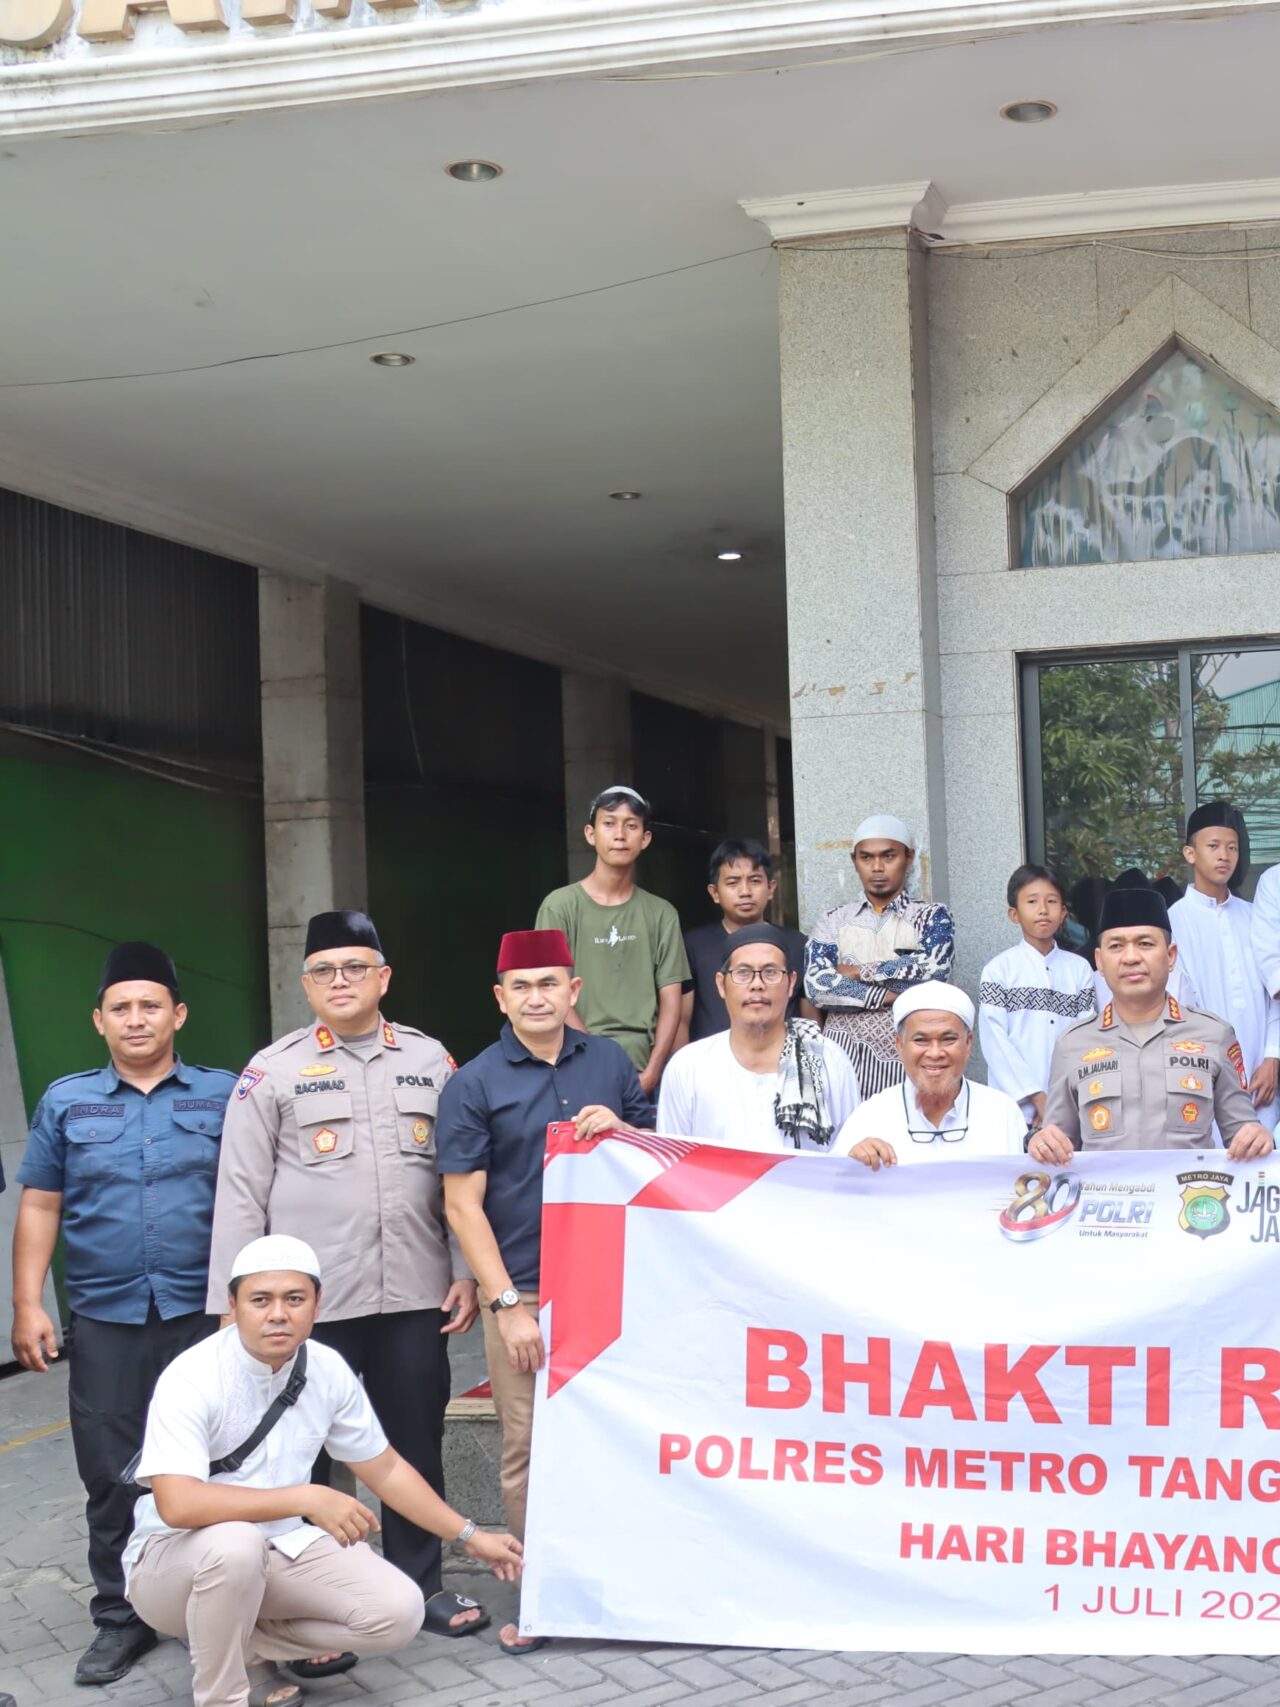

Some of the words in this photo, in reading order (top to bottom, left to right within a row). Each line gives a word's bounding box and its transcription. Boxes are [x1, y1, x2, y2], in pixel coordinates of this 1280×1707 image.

[1170, 1056, 1209, 1070] POLRI
[294, 1079, 346, 1095] RACHMAD
[396, 1075, 434, 1088] POLRI
[1181, 1173, 1208, 1183] METRO
[1210, 1173, 1229, 1183] JAYA
[1108, 1182, 1156, 1194] Mengabdi
[1078, 1200, 1154, 1223] POLRI
[1079, 1229, 1101, 1237] Untuk
[1103, 1230, 1148, 1239] Masyarakat
[745, 1327, 1171, 1426] BHAKTI
[659, 1432, 884, 1486] POLRES
[904, 1446, 1108, 1496] METRO
[900, 1522, 1025, 1564] HARI
[1044, 1583, 1060, 1612] 1
[1082, 1586, 1182, 1617] JULI
